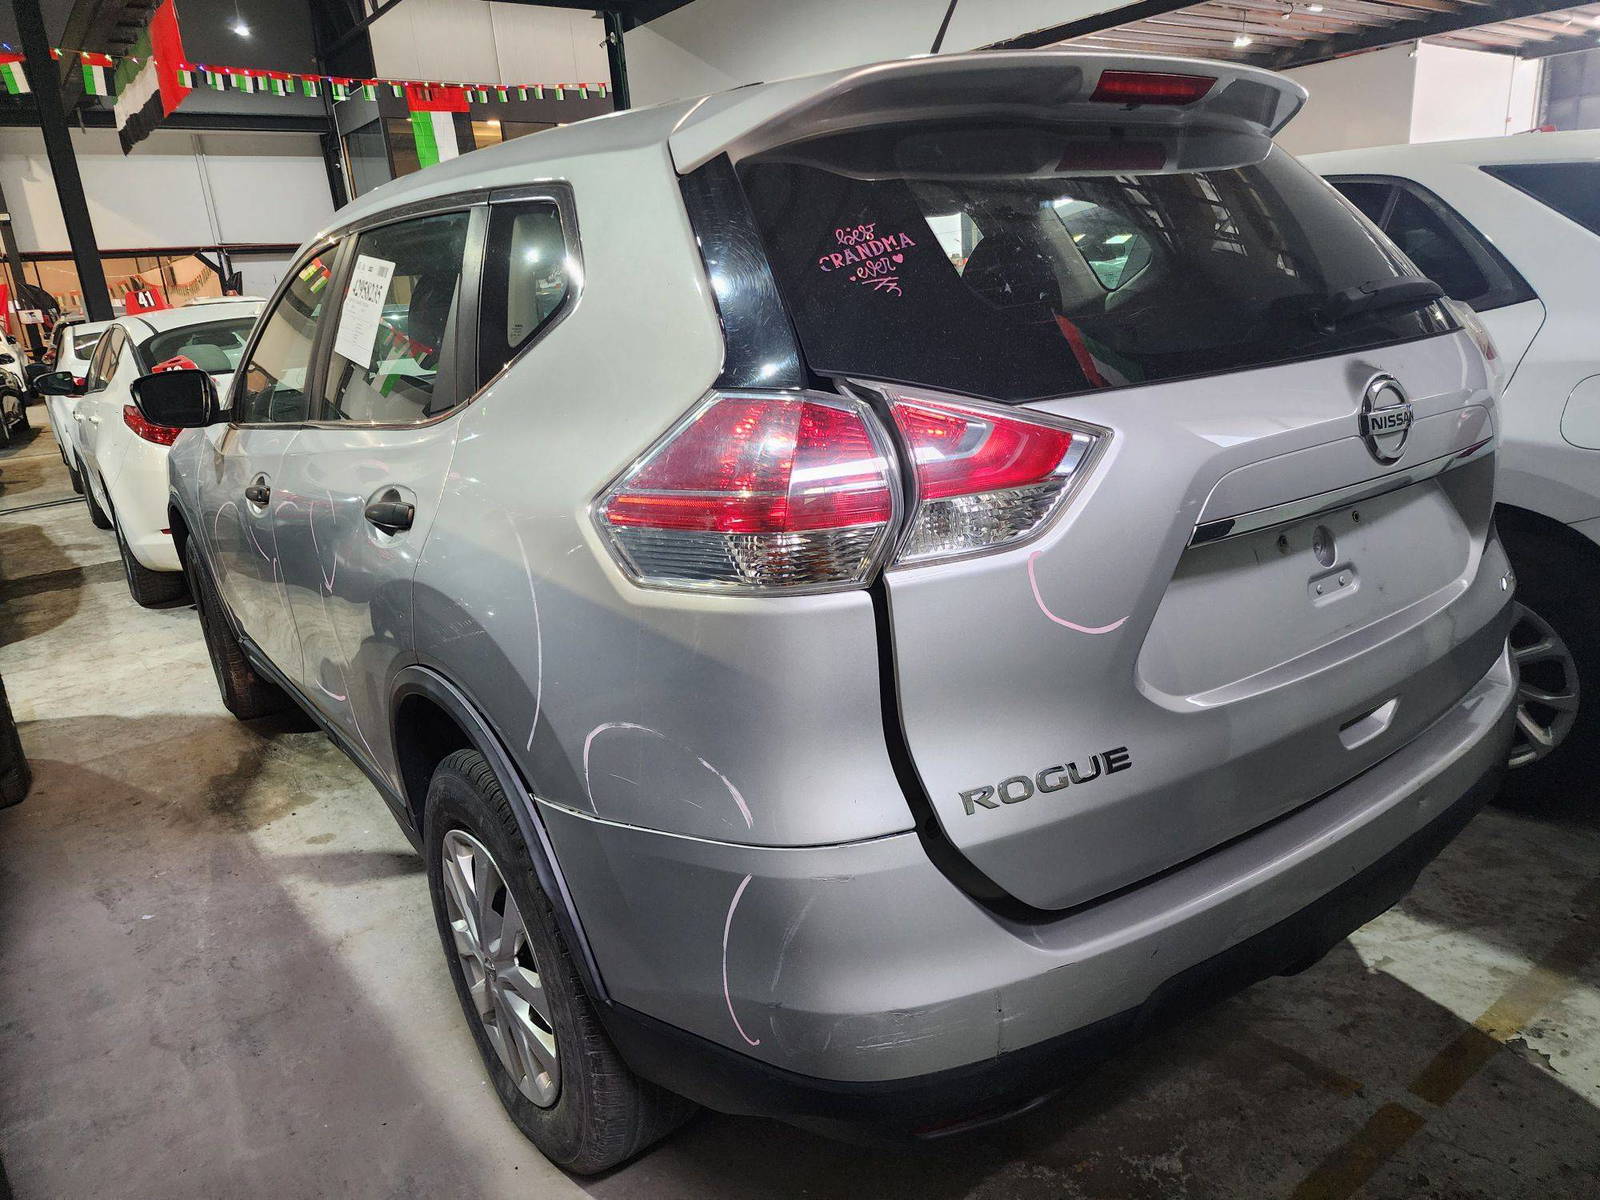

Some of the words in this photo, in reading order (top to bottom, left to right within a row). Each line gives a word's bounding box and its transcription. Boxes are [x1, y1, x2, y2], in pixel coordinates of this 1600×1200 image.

[138, 290, 156, 308] 41
[1370, 410, 1414, 430] NISSAN
[958, 746, 1132, 815] ROGUE
